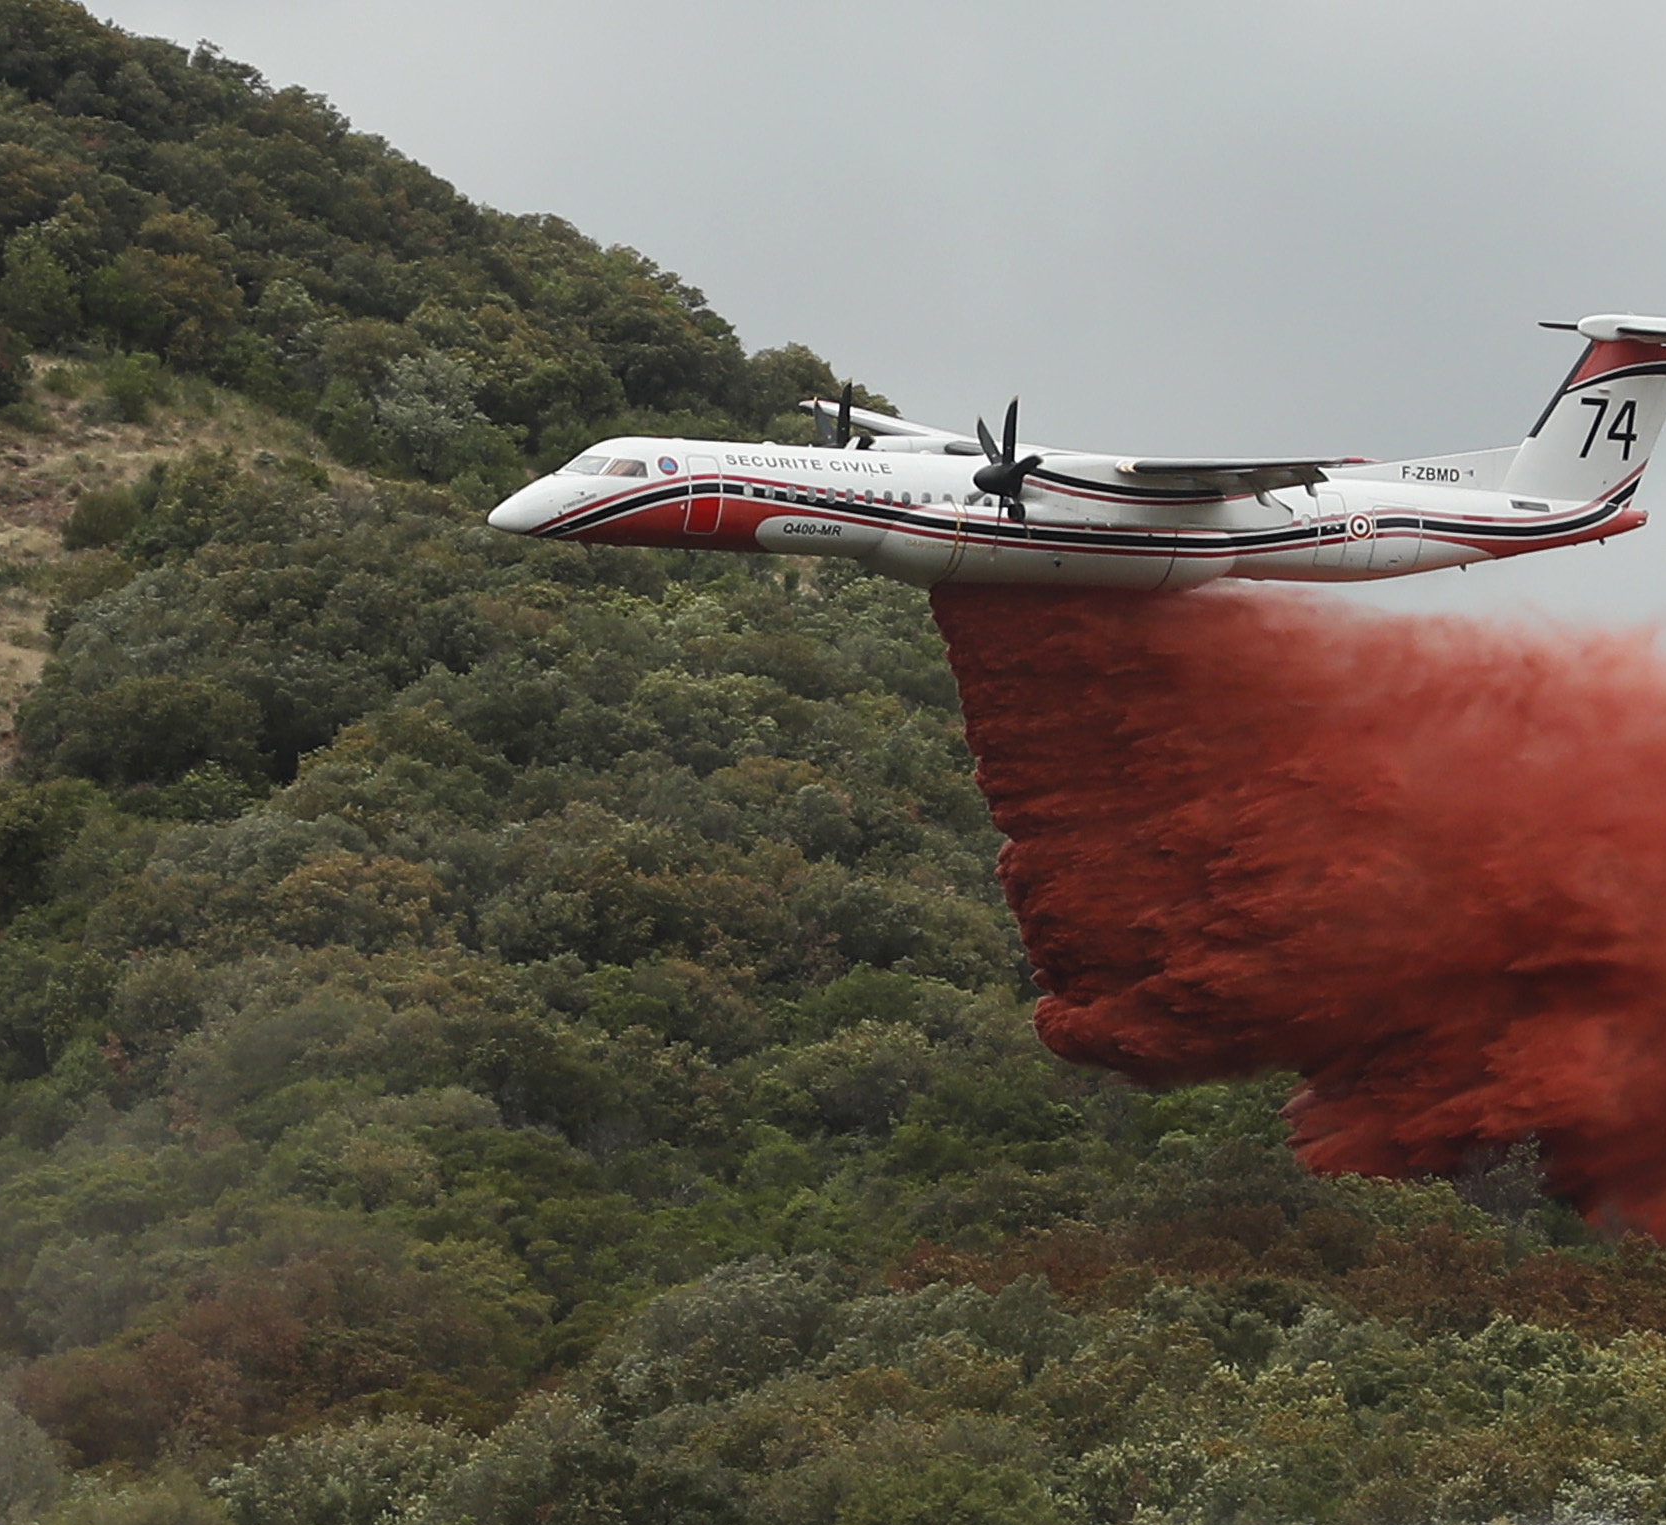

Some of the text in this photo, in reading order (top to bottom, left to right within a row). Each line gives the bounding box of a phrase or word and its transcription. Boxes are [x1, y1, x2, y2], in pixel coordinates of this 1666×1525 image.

[1580, 396, 1638, 462] 74
[724, 453, 893, 475] SECURITE CIVILE
[1401, 465, 1461, 483] F-ZBMD
[783, 522, 843, 537] Q400-MR
